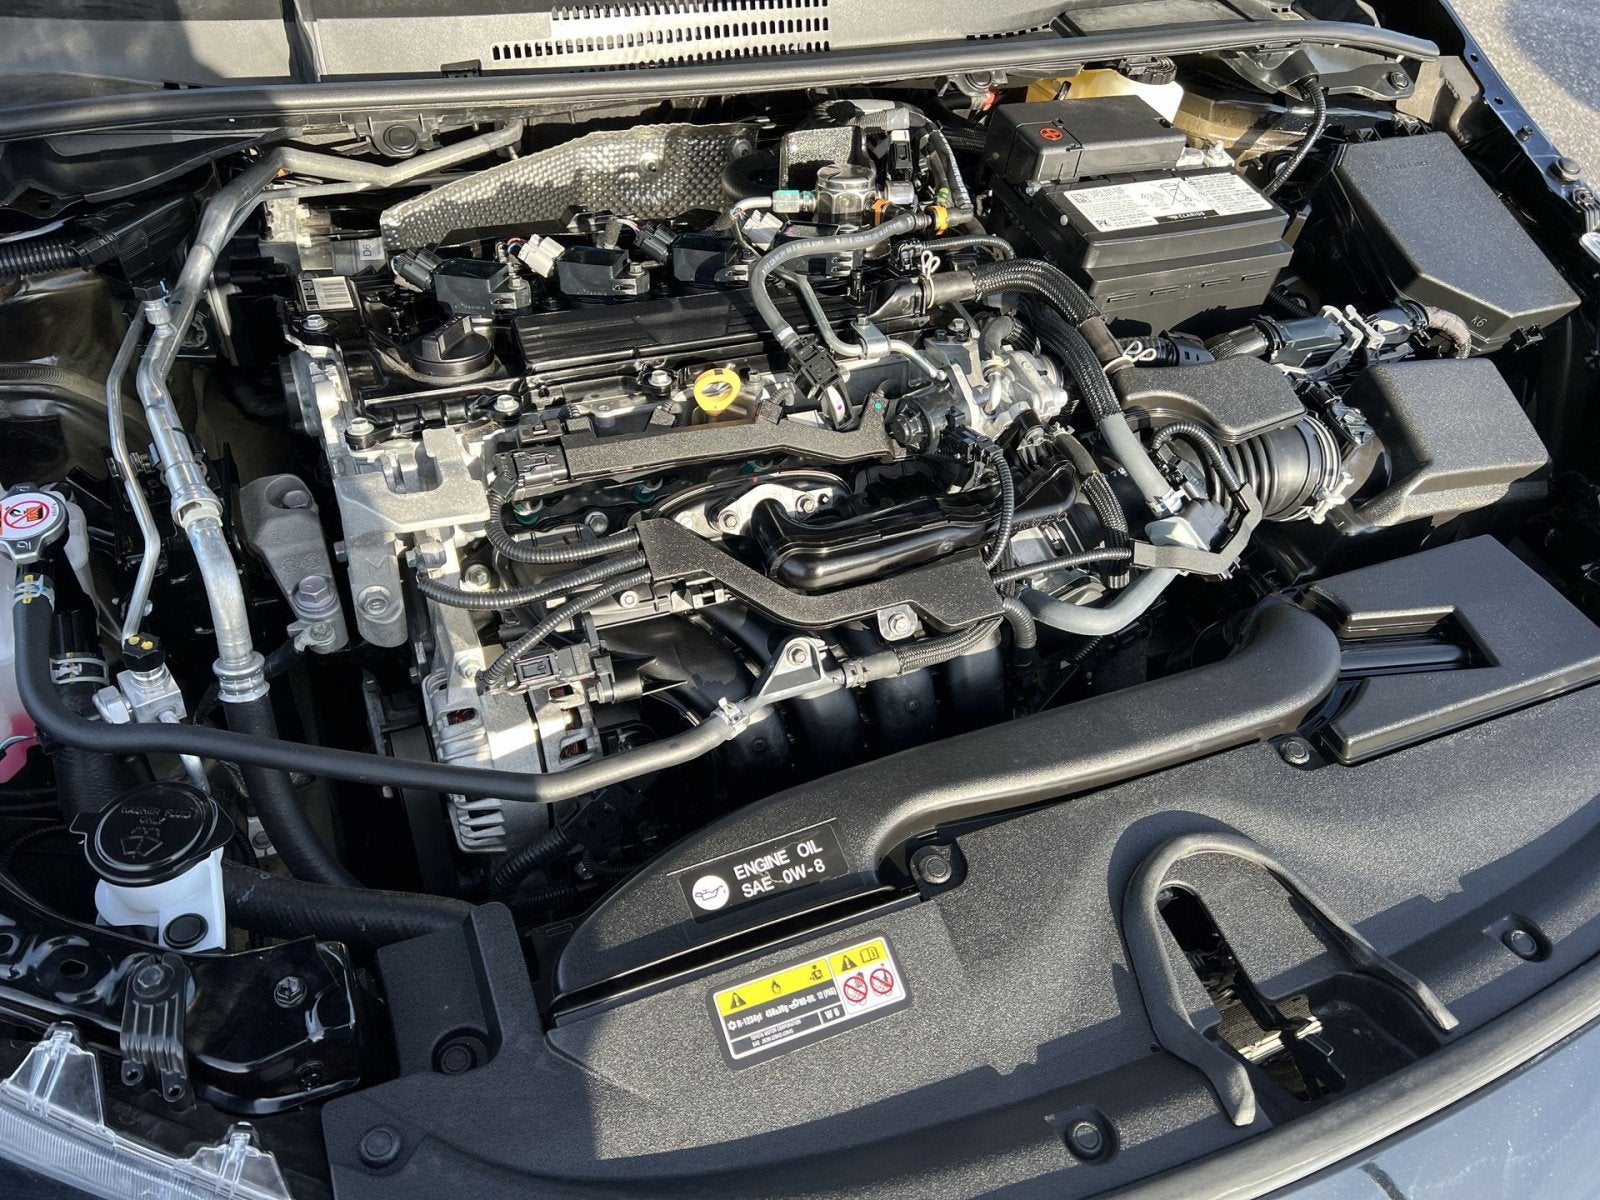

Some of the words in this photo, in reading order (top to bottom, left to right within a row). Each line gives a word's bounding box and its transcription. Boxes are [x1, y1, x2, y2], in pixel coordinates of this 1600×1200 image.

[733, 849, 790, 880] ENGINE
[796, 839, 823, 858] OIL
[741, 875, 775, 898] SAE
[782, 858, 826, 884] 0W-8
